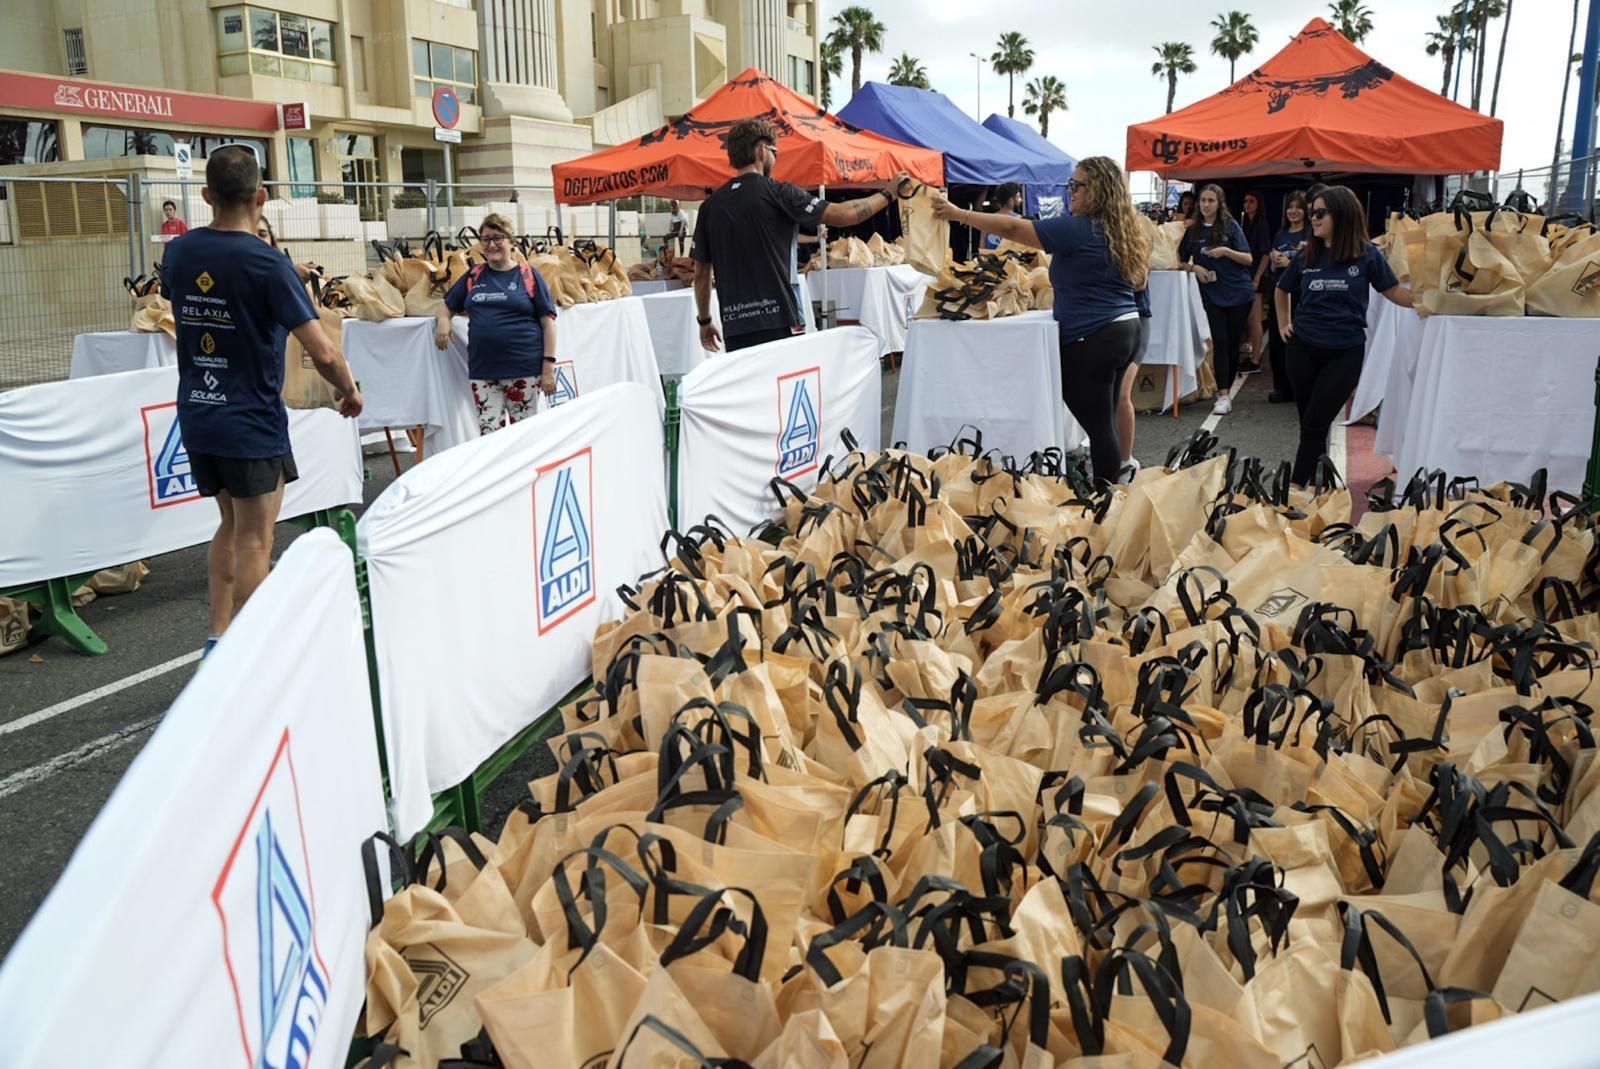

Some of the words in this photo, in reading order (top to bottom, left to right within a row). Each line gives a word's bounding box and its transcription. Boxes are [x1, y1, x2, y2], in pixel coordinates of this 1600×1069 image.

[84, 88, 174, 116] GENERALI
[1152, 133, 1181, 165] dg
[182, 306, 231, 319] RELAXIA
[190, 390, 227, 402] SOLINCA
[781, 443, 815, 471] ALDI
[163, 474, 199, 497] AL
[547, 564, 588, 613] ALDI
[421, 972, 459, 1019] ALDI
